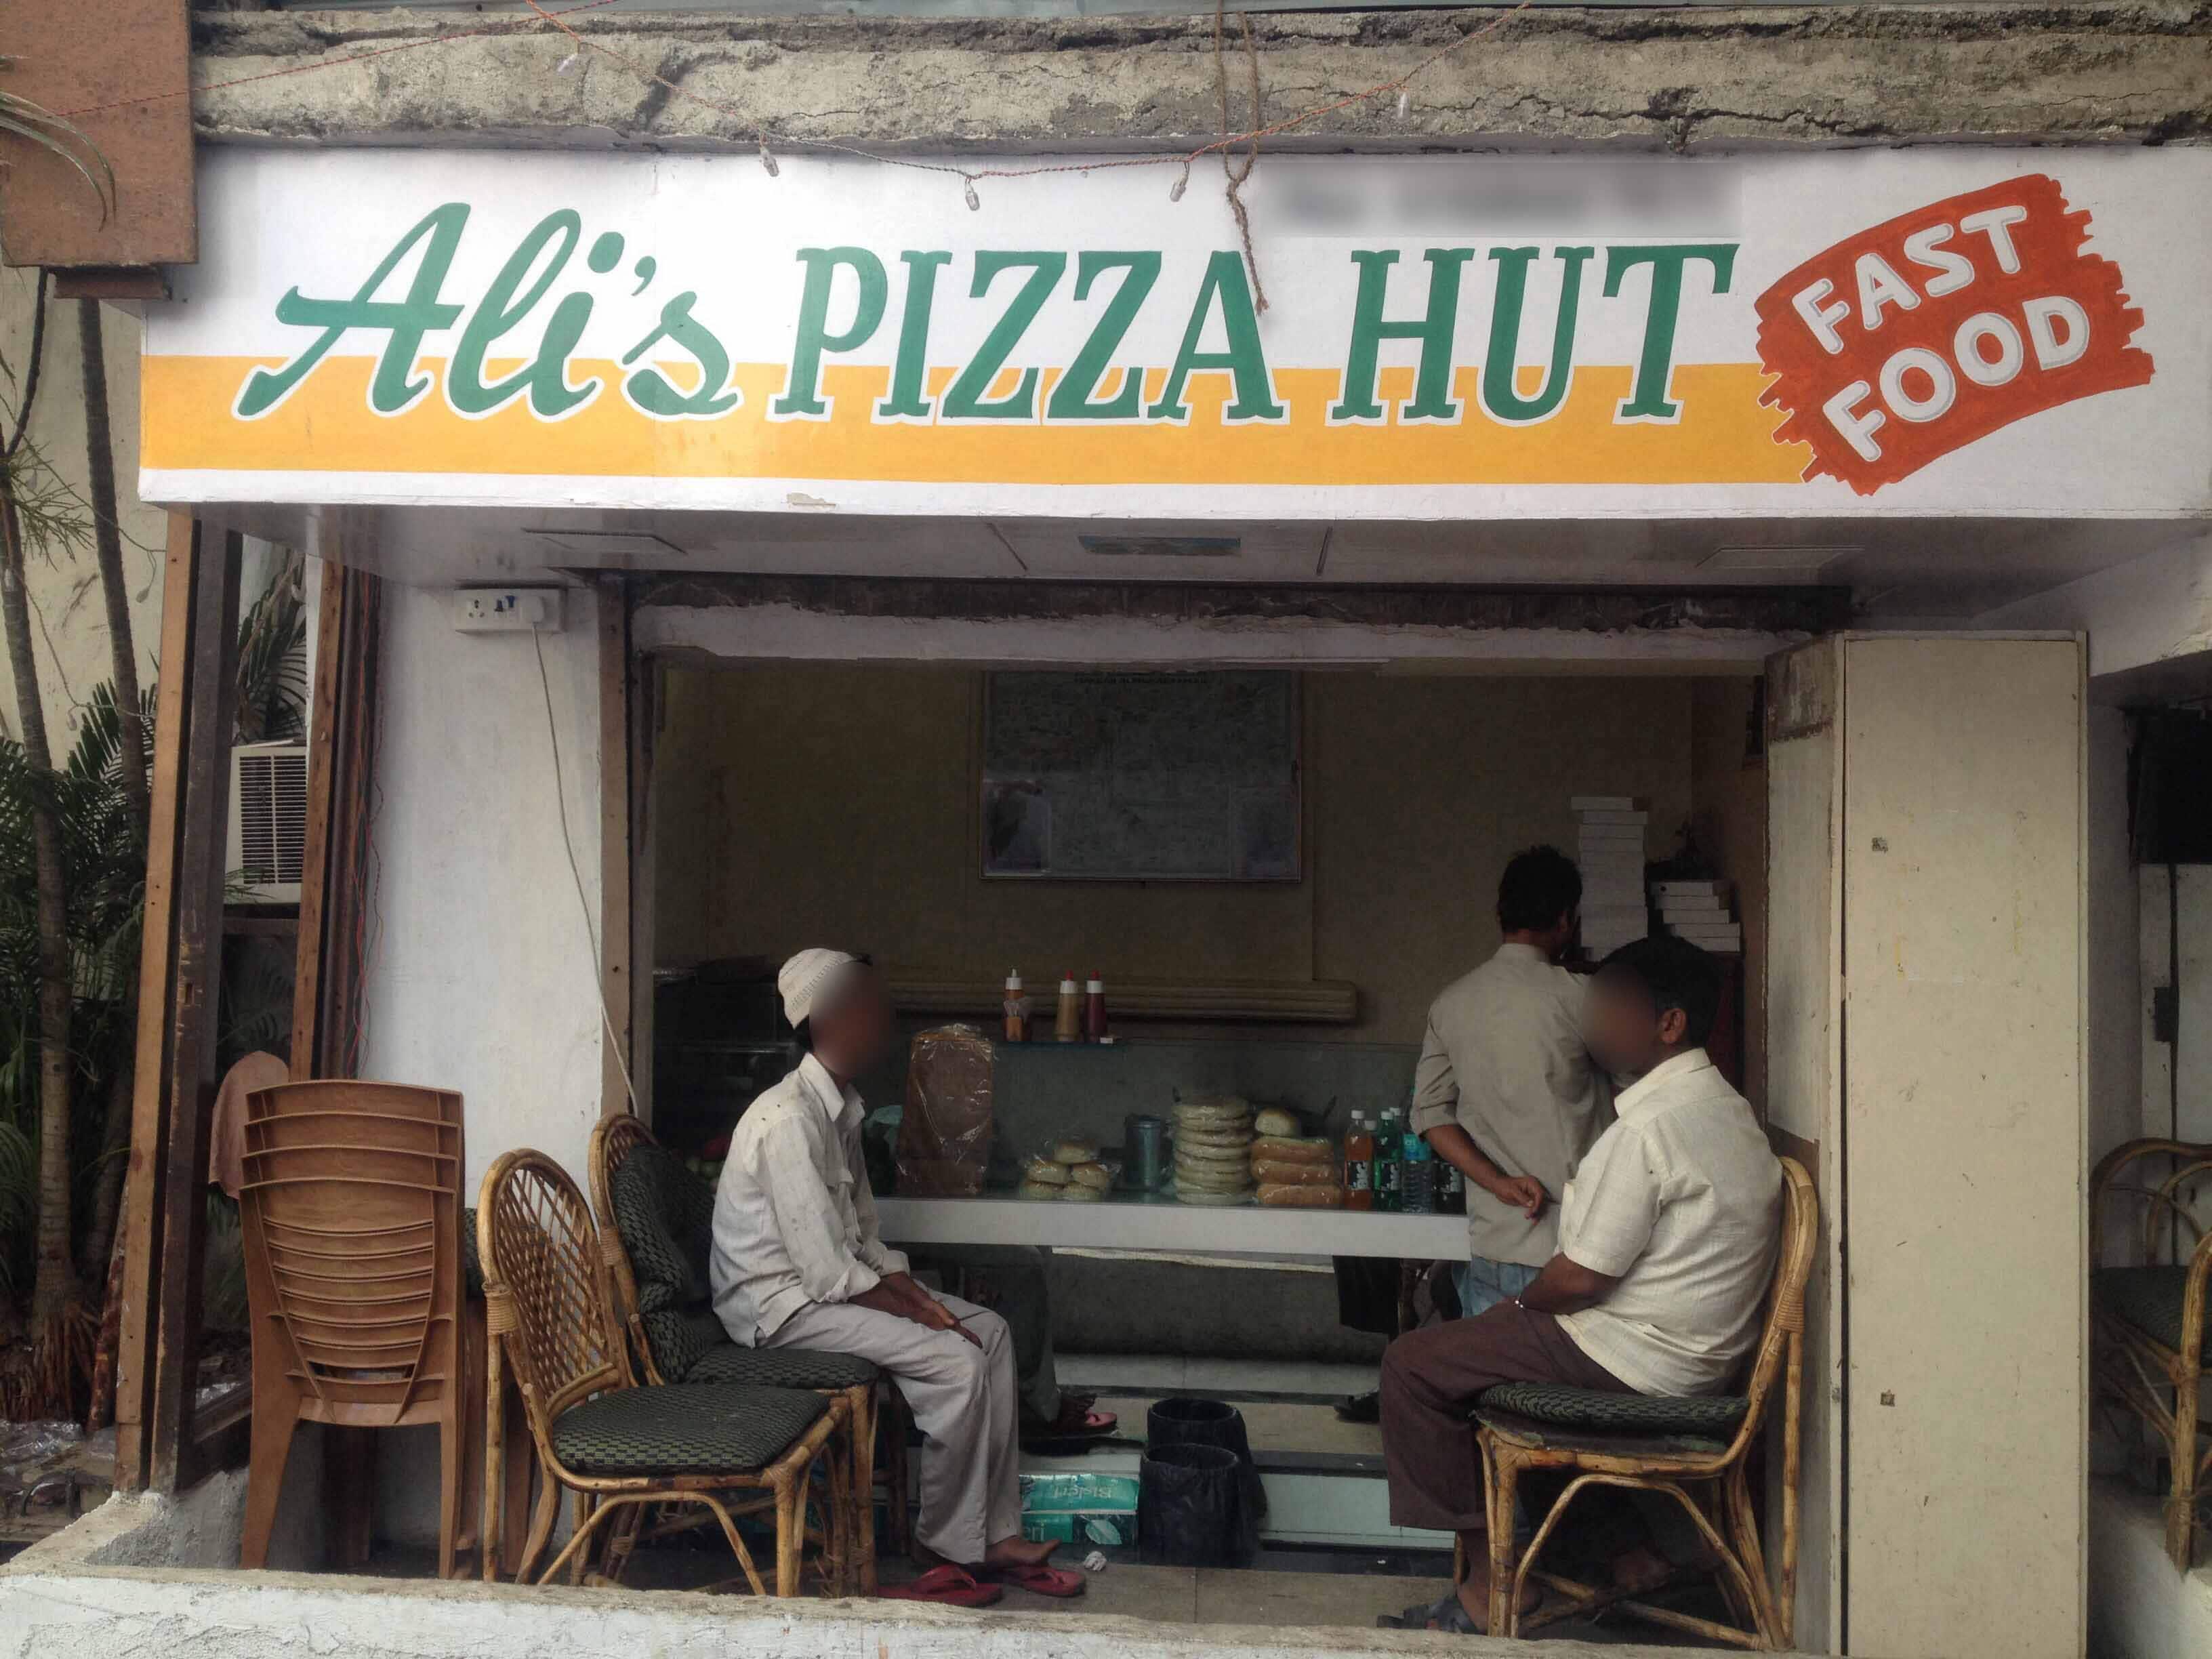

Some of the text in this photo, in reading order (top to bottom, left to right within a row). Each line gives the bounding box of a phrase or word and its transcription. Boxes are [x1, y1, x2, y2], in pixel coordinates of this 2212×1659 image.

[237, 202, 1740, 421] Ali's PIZZA HUT
[1791, 205, 2027, 354] FAST
[1822, 295, 2091, 462] FOOD
